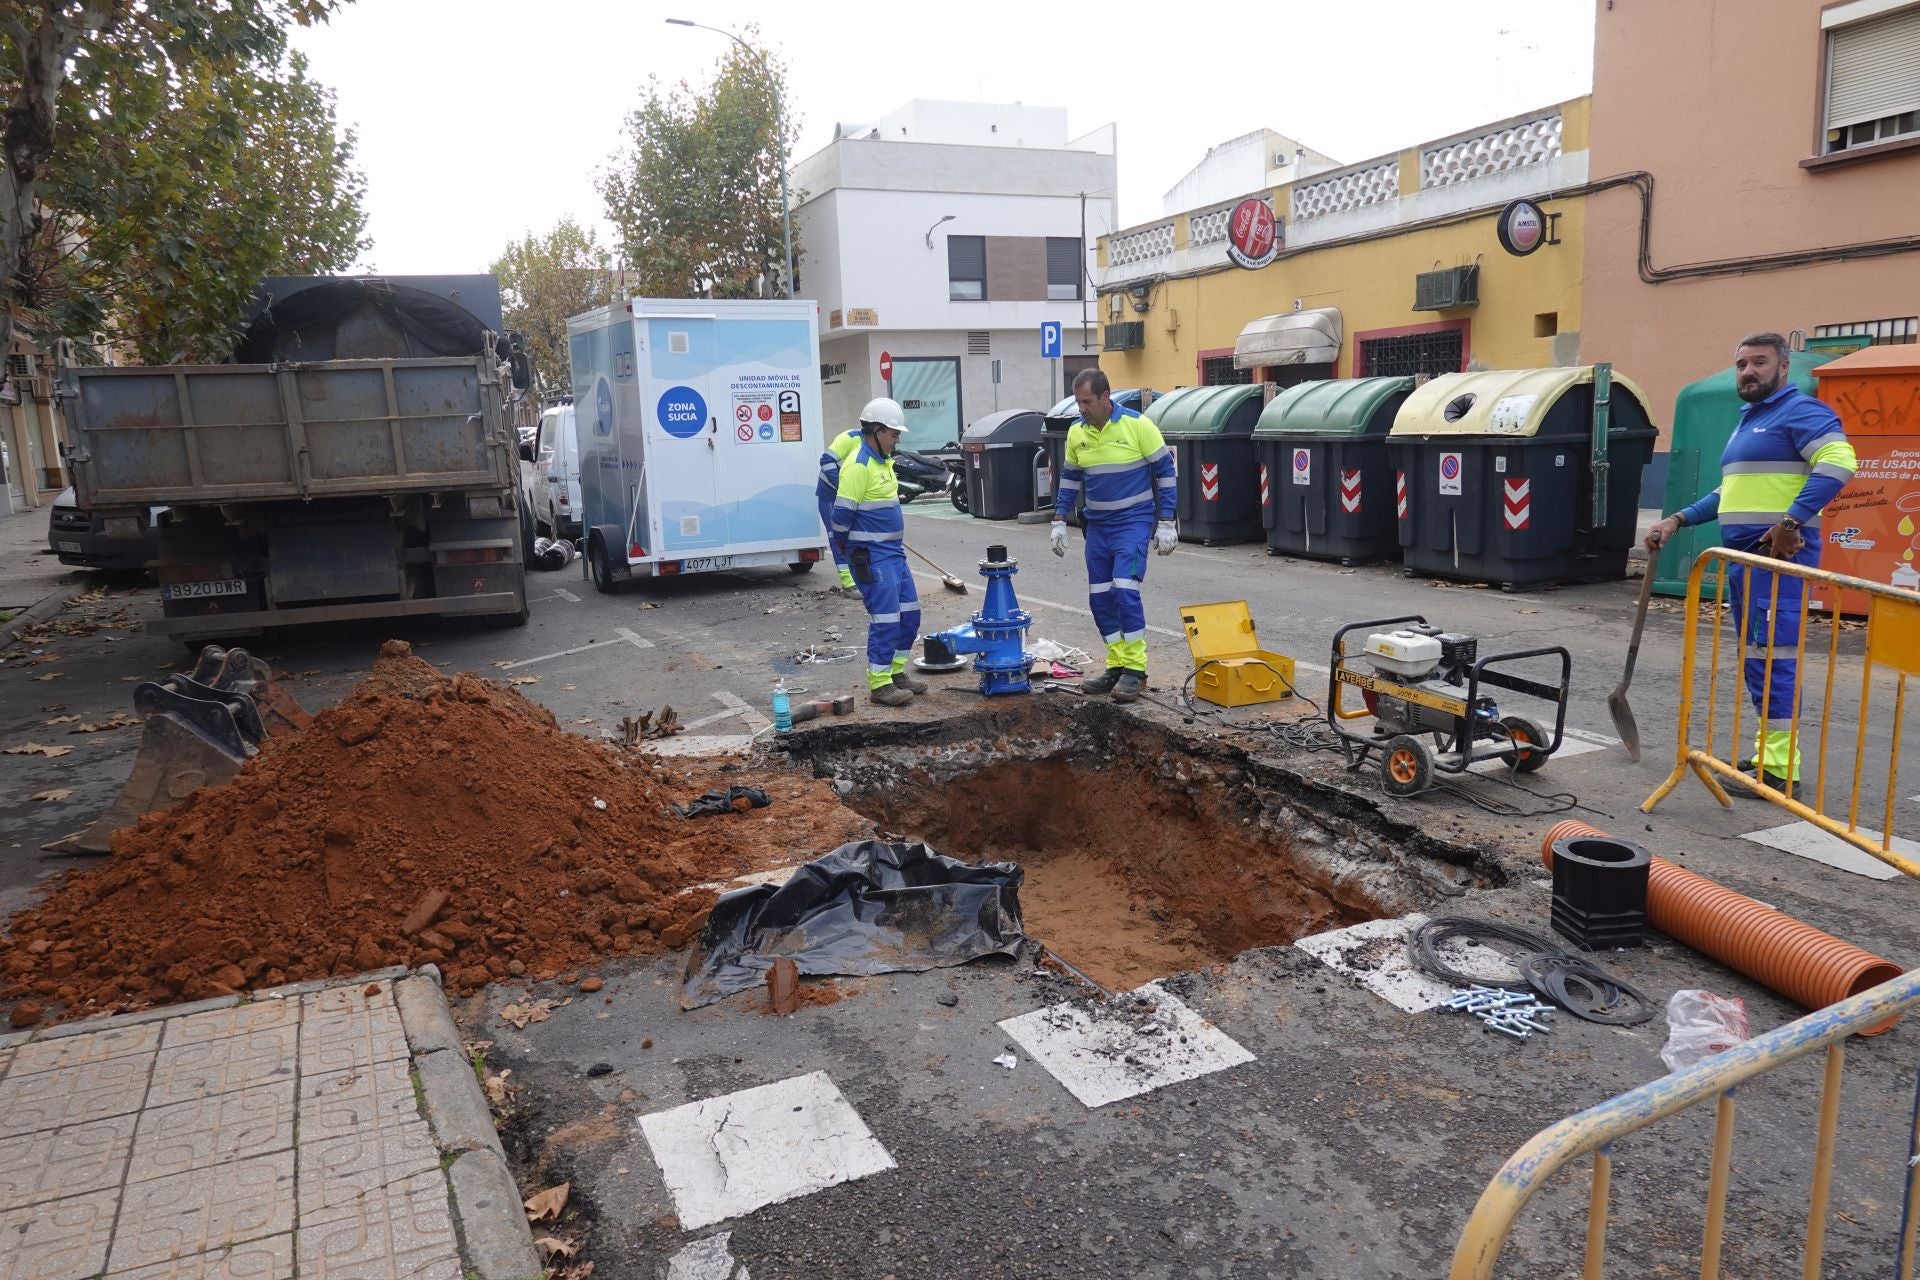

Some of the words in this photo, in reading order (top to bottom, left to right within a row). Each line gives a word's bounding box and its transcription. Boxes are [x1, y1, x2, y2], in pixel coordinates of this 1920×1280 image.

[1045, 325, 1056, 354] P
[667, 402, 697, 412] ZONA
[667, 412, 698, 422] SUCIA
[1854, 471, 1898, 479] ENVASES
[1899, 472, 1911, 480] de
[1833, 489, 1874, 502] Cuidamos
[1876, 486, 1885, 495] el
[1827, 502, 1851, 517] medio
[1853, 498, 1889, 509] ambiente
[1831, 532, 1854, 544] FCC
[686, 558, 711, 570] 4077
[714, 556, 733, 567] LJT
[172, 583, 211, 597] 9920
[214, 580, 243, 594] DWR
[1339, 671, 1373, 689] AYERBE
